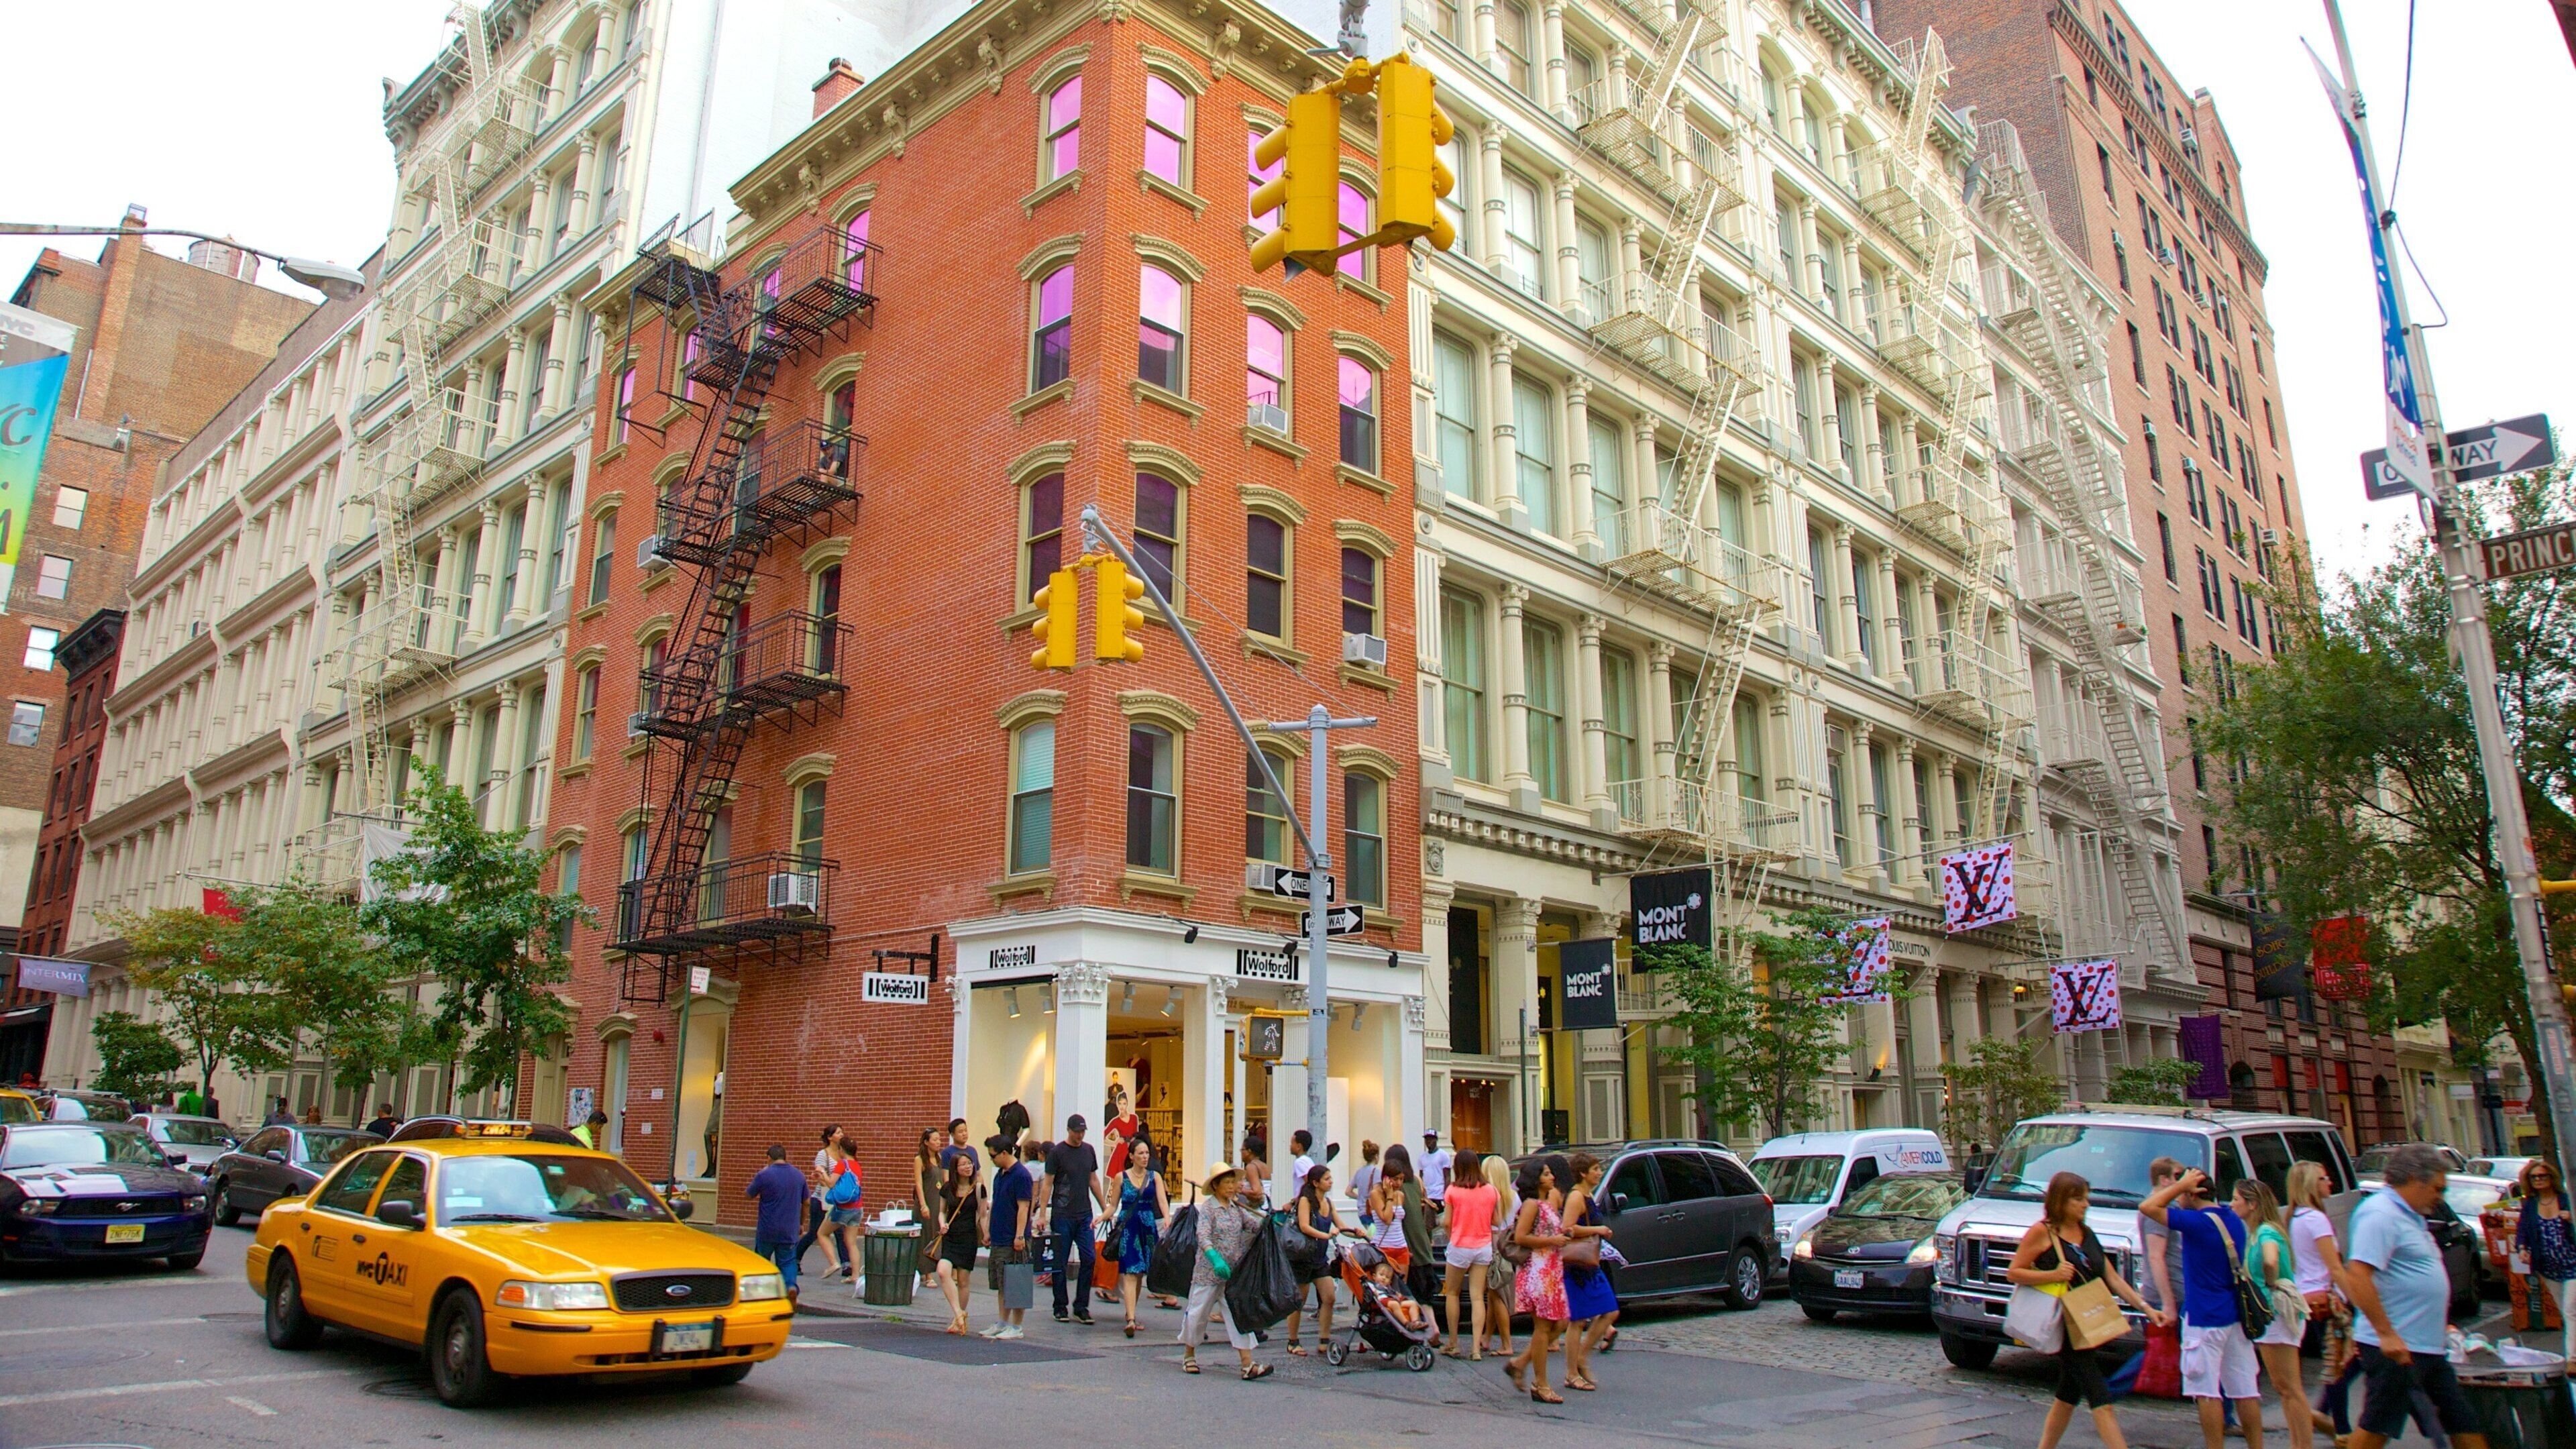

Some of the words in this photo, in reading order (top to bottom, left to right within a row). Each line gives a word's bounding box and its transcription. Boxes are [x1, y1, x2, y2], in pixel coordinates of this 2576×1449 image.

[2489, 527, 2576, 576] PRINC
[1291, 878, 1307, 891] ONE
[1328, 916, 1346, 927] WAY
[1638, 904, 1687, 926] MONT
[1639, 922, 1686, 943] BLANC
[1888, 939, 1903, 953] OUIS
[1903, 943, 1930, 957] VUITTON
[998, 951, 1028, 963] Wolford
[1247, 957, 1289, 973] Wolford
[23, 968, 86, 983] INTERMIX
[1566, 971, 1602, 985] MONT
[881, 982, 913, 995] Wolford
[1567, 984, 1603, 998] BLANC
[1900, 1150, 1943, 1165] AMERICOLD
[375, 1252, 409, 1287] TAXI
